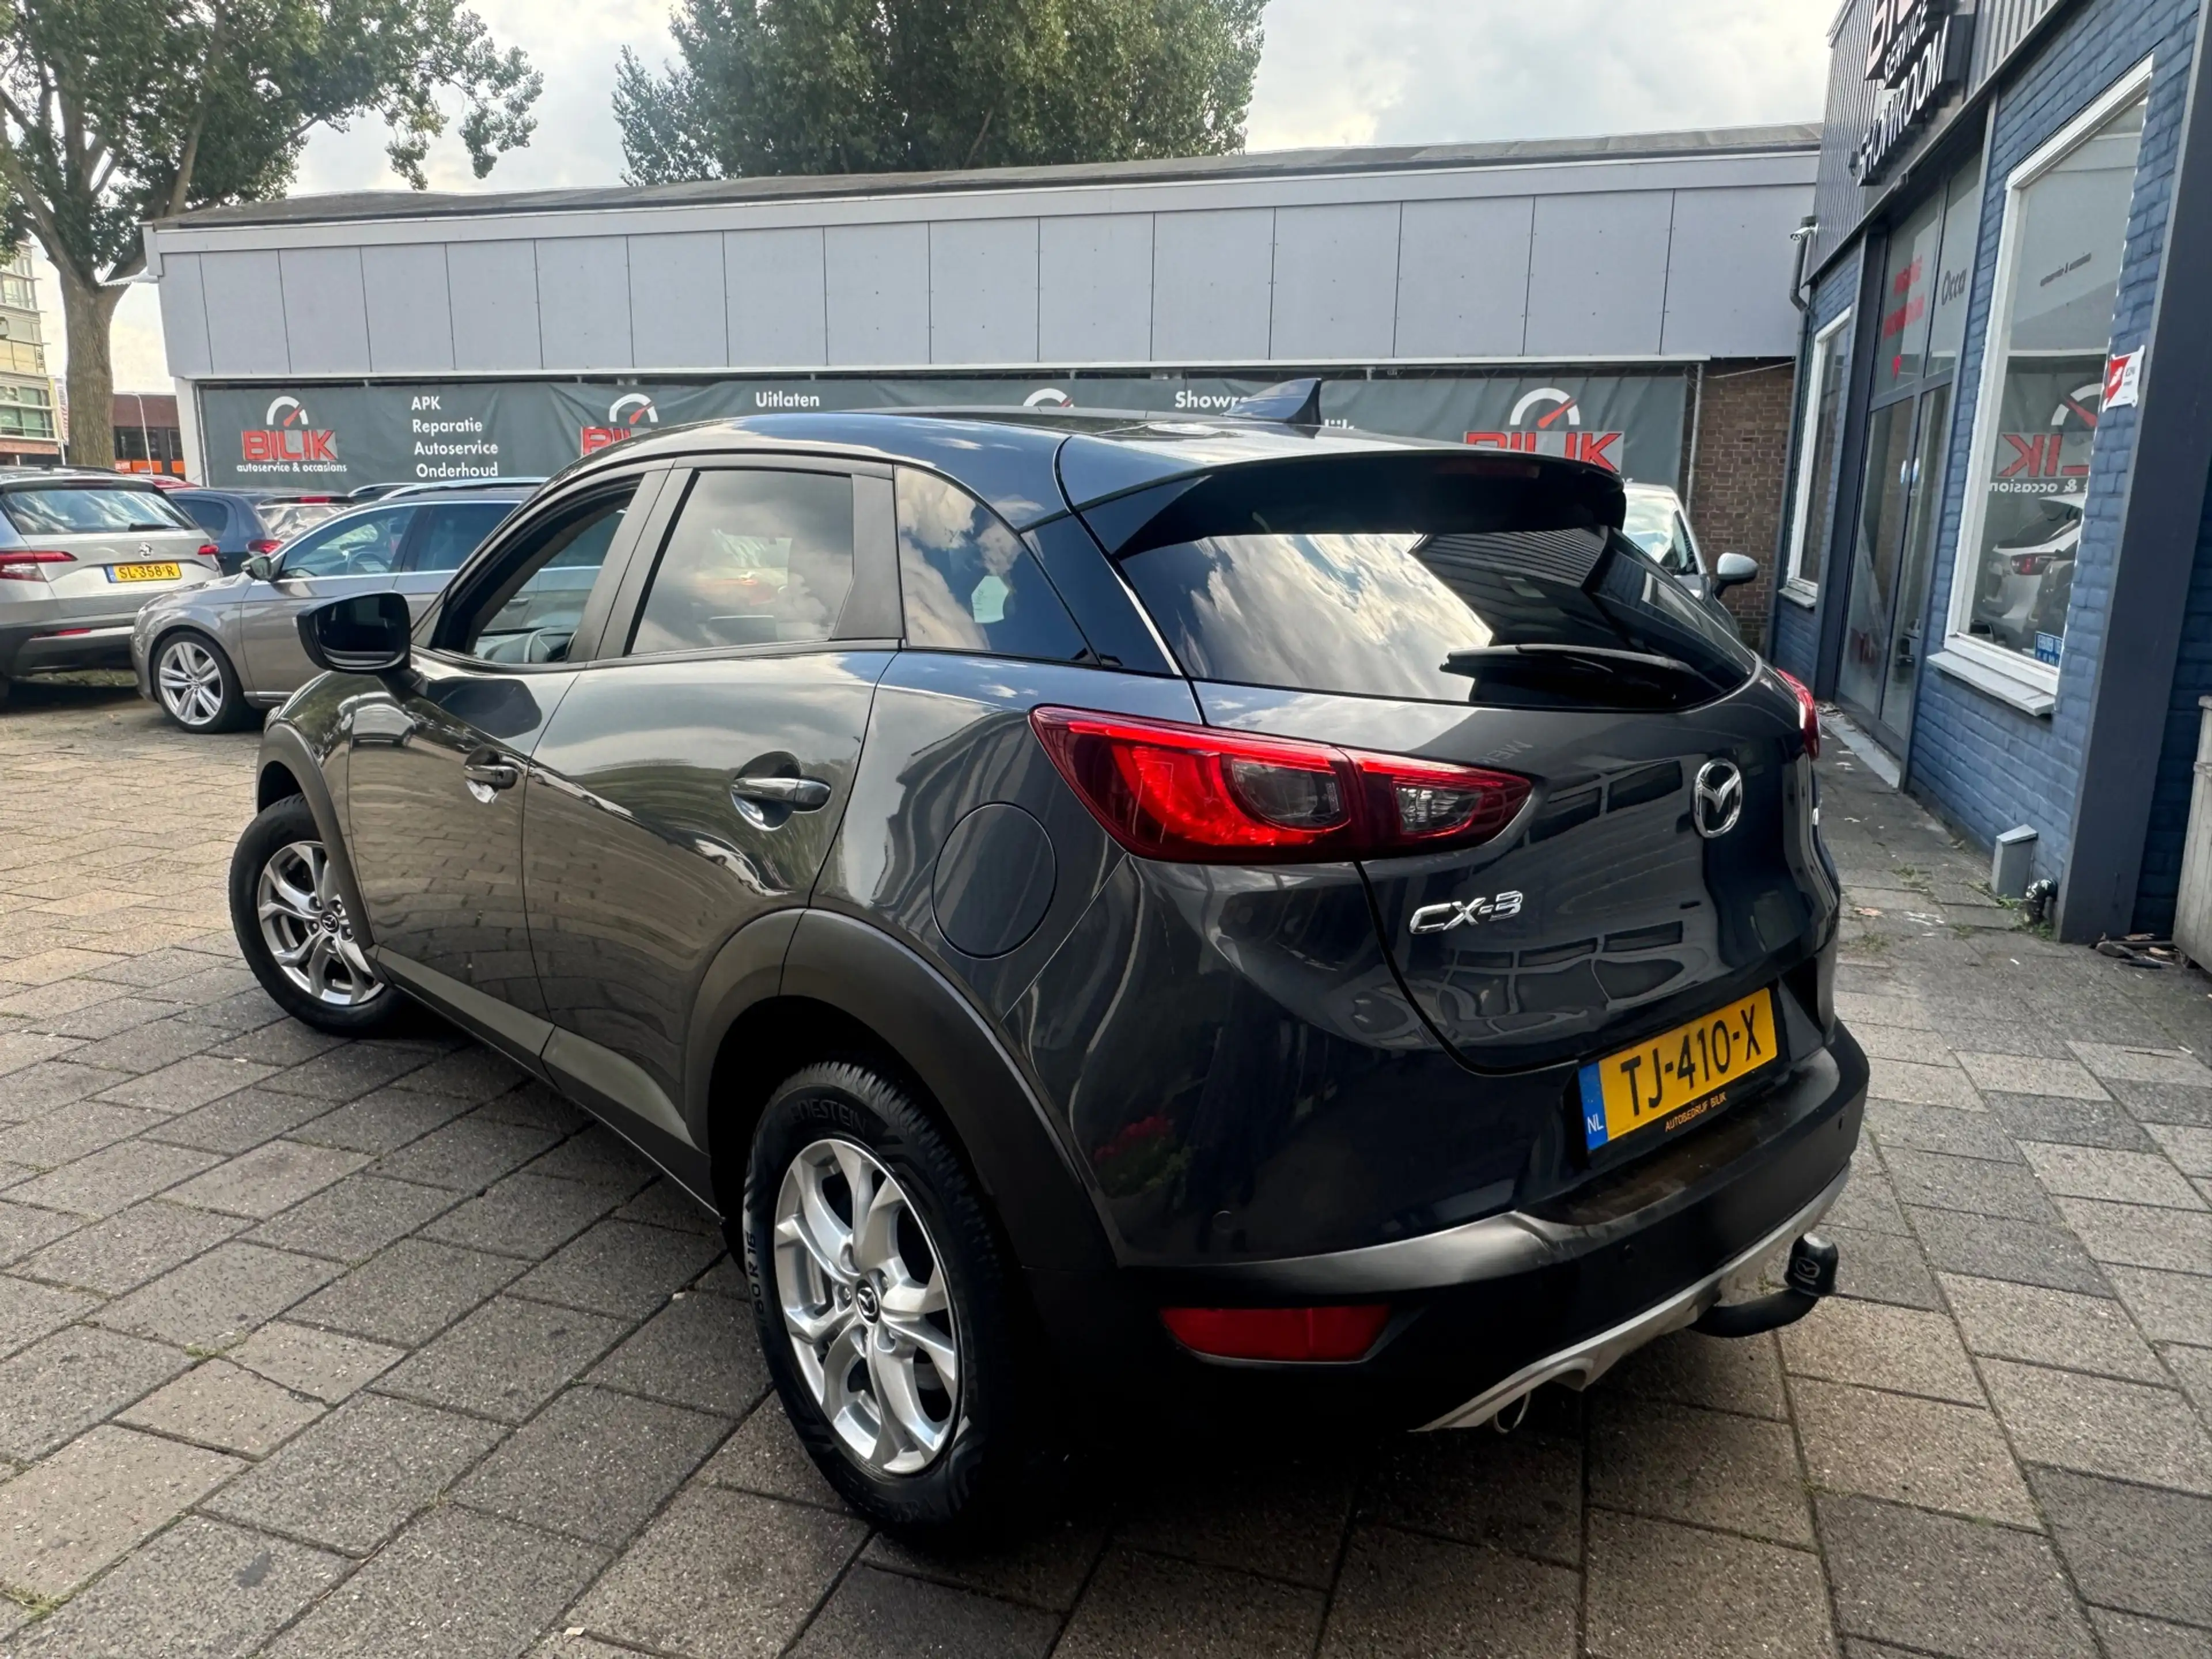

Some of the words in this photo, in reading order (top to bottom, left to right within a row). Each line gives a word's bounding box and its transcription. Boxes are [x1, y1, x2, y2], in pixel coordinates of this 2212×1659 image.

[1857, 14, 1950, 187] SHOWROOM
[411, 396, 442, 410] APK
[756, 391, 820, 407] Uitlaten
[412, 417, 483, 437] Reparatie
[243, 430, 337, 461] BILIK
[414, 440, 498, 456] Autoservice
[236, 463, 290, 472] autoservice
[293, 463, 300, 472] &
[302, 463, 347, 472] occasions
[416, 462, 498, 478] Onderhoud
[1410, 891, 1523, 934] CX-3
[1620, 1003, 1762, 1117] TJ-410-X
[1586, 1113, 1604, 1135] NL
